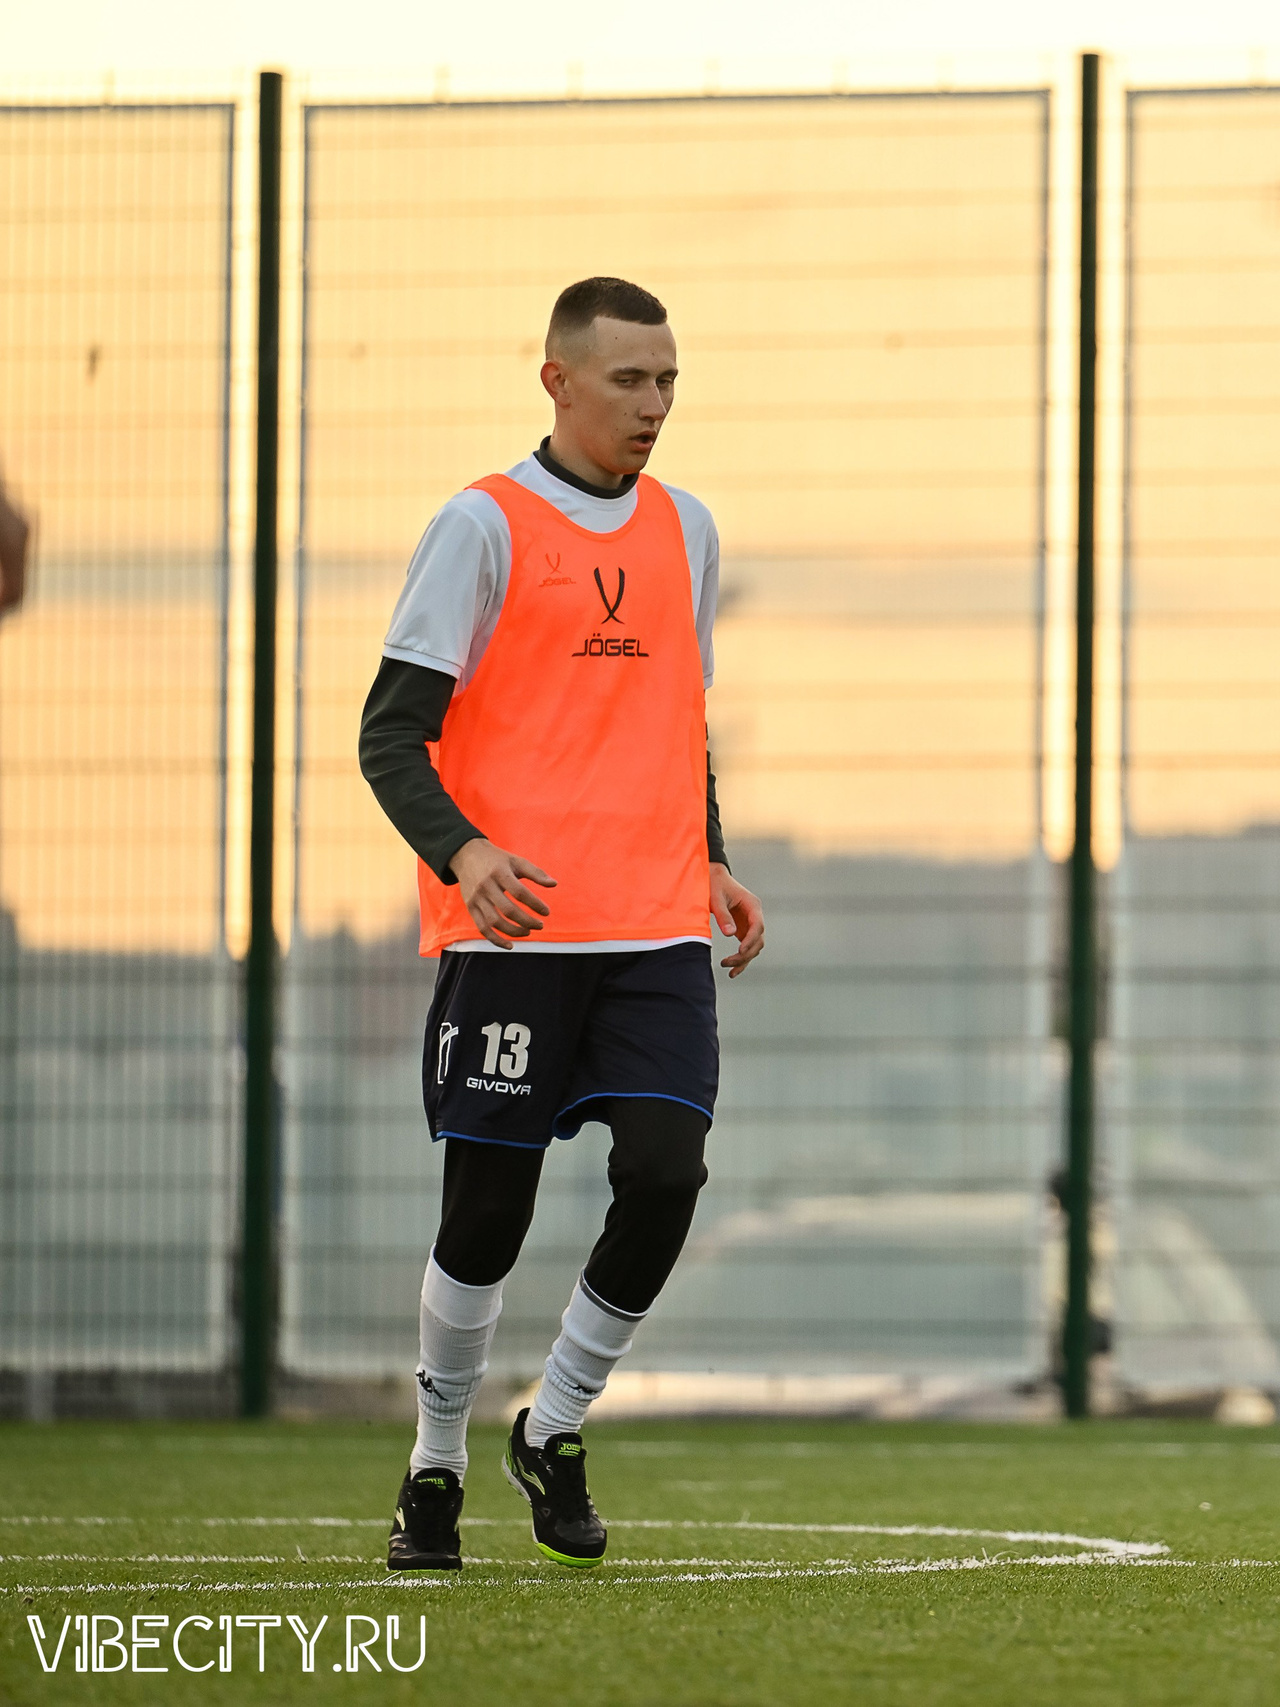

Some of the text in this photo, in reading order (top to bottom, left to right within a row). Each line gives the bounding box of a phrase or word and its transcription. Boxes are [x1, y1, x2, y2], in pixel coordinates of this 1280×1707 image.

[571, 632, 650, 658] JÖGEL
[481, 1021, 532, 1080] 13
[465, 1076, 532, 1096] GIVOVA
